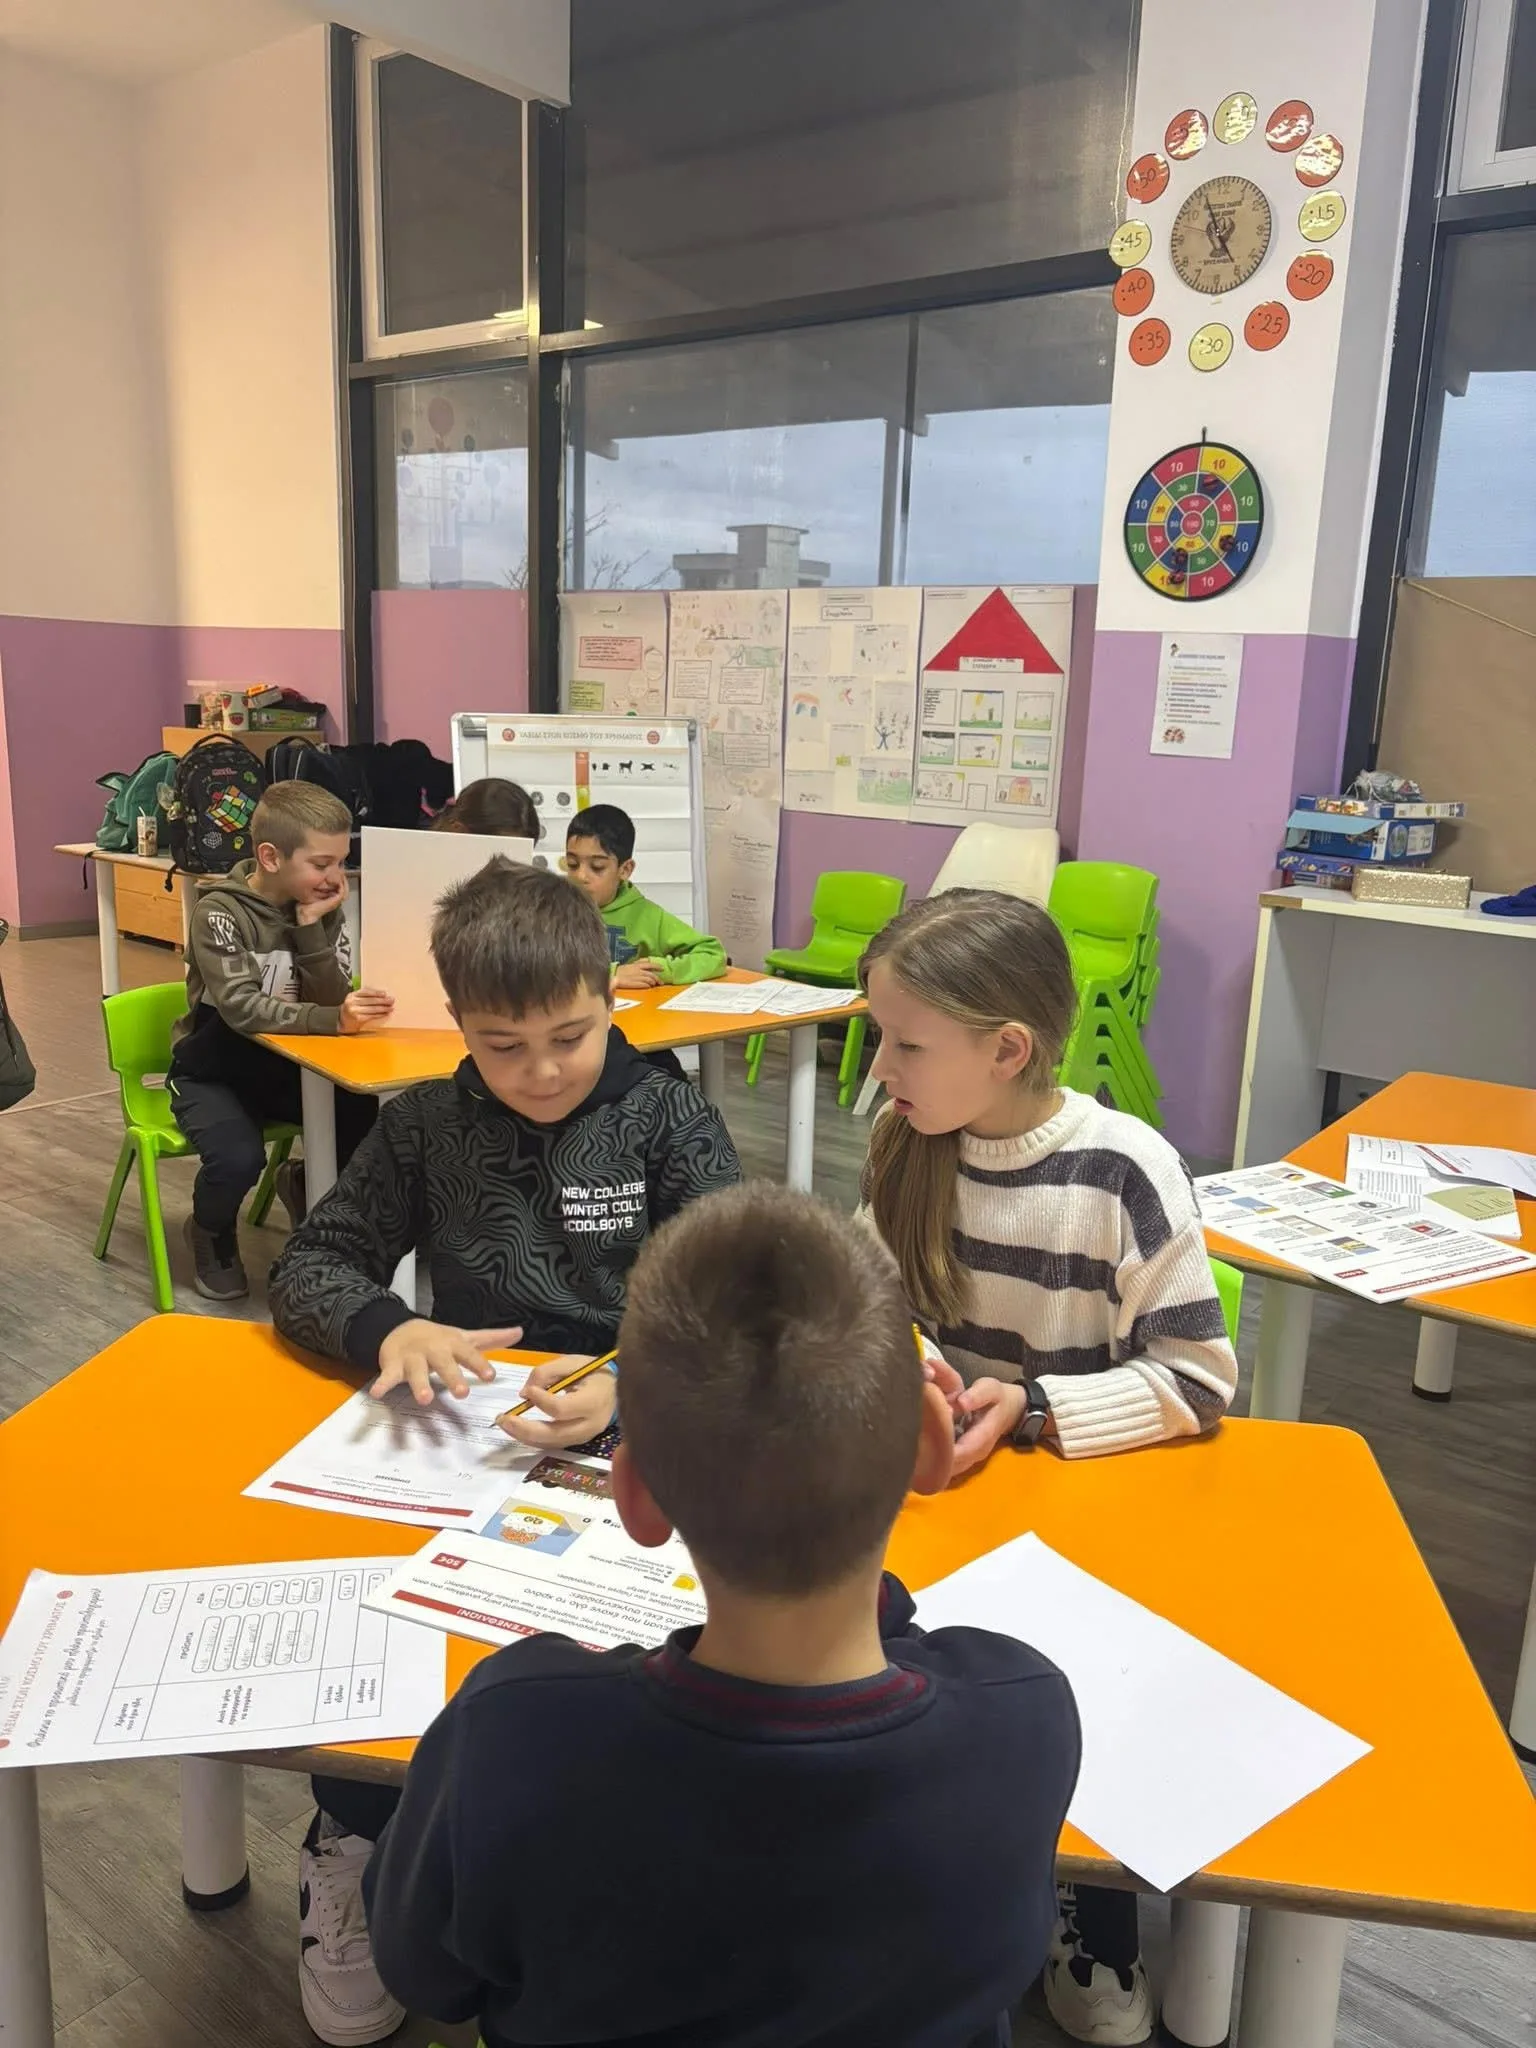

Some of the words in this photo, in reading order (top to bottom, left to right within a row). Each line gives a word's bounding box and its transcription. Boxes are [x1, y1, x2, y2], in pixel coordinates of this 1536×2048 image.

[1170, 462, 1184, 473] 10
[1212, 459, 1227, 470] 10
[1135, 501, 1148, 511] 10
[1240, 496, 1254, 507] 10
[1205, 519, 1216, 528] 70
[1132, 543, 1146, 553] 10
[1236, 541, 1250, 552] 10
[1201, 577, 1215, 588] 10
[562, 1187, 590, 1199] NEW
[594, 1181, 645, 1199] COLLEGE
[562, 1203, 608, 1216] WINTER
[612, 1199, 643, 1213] COLL
[438, 1556, 460, 1566] 50€
